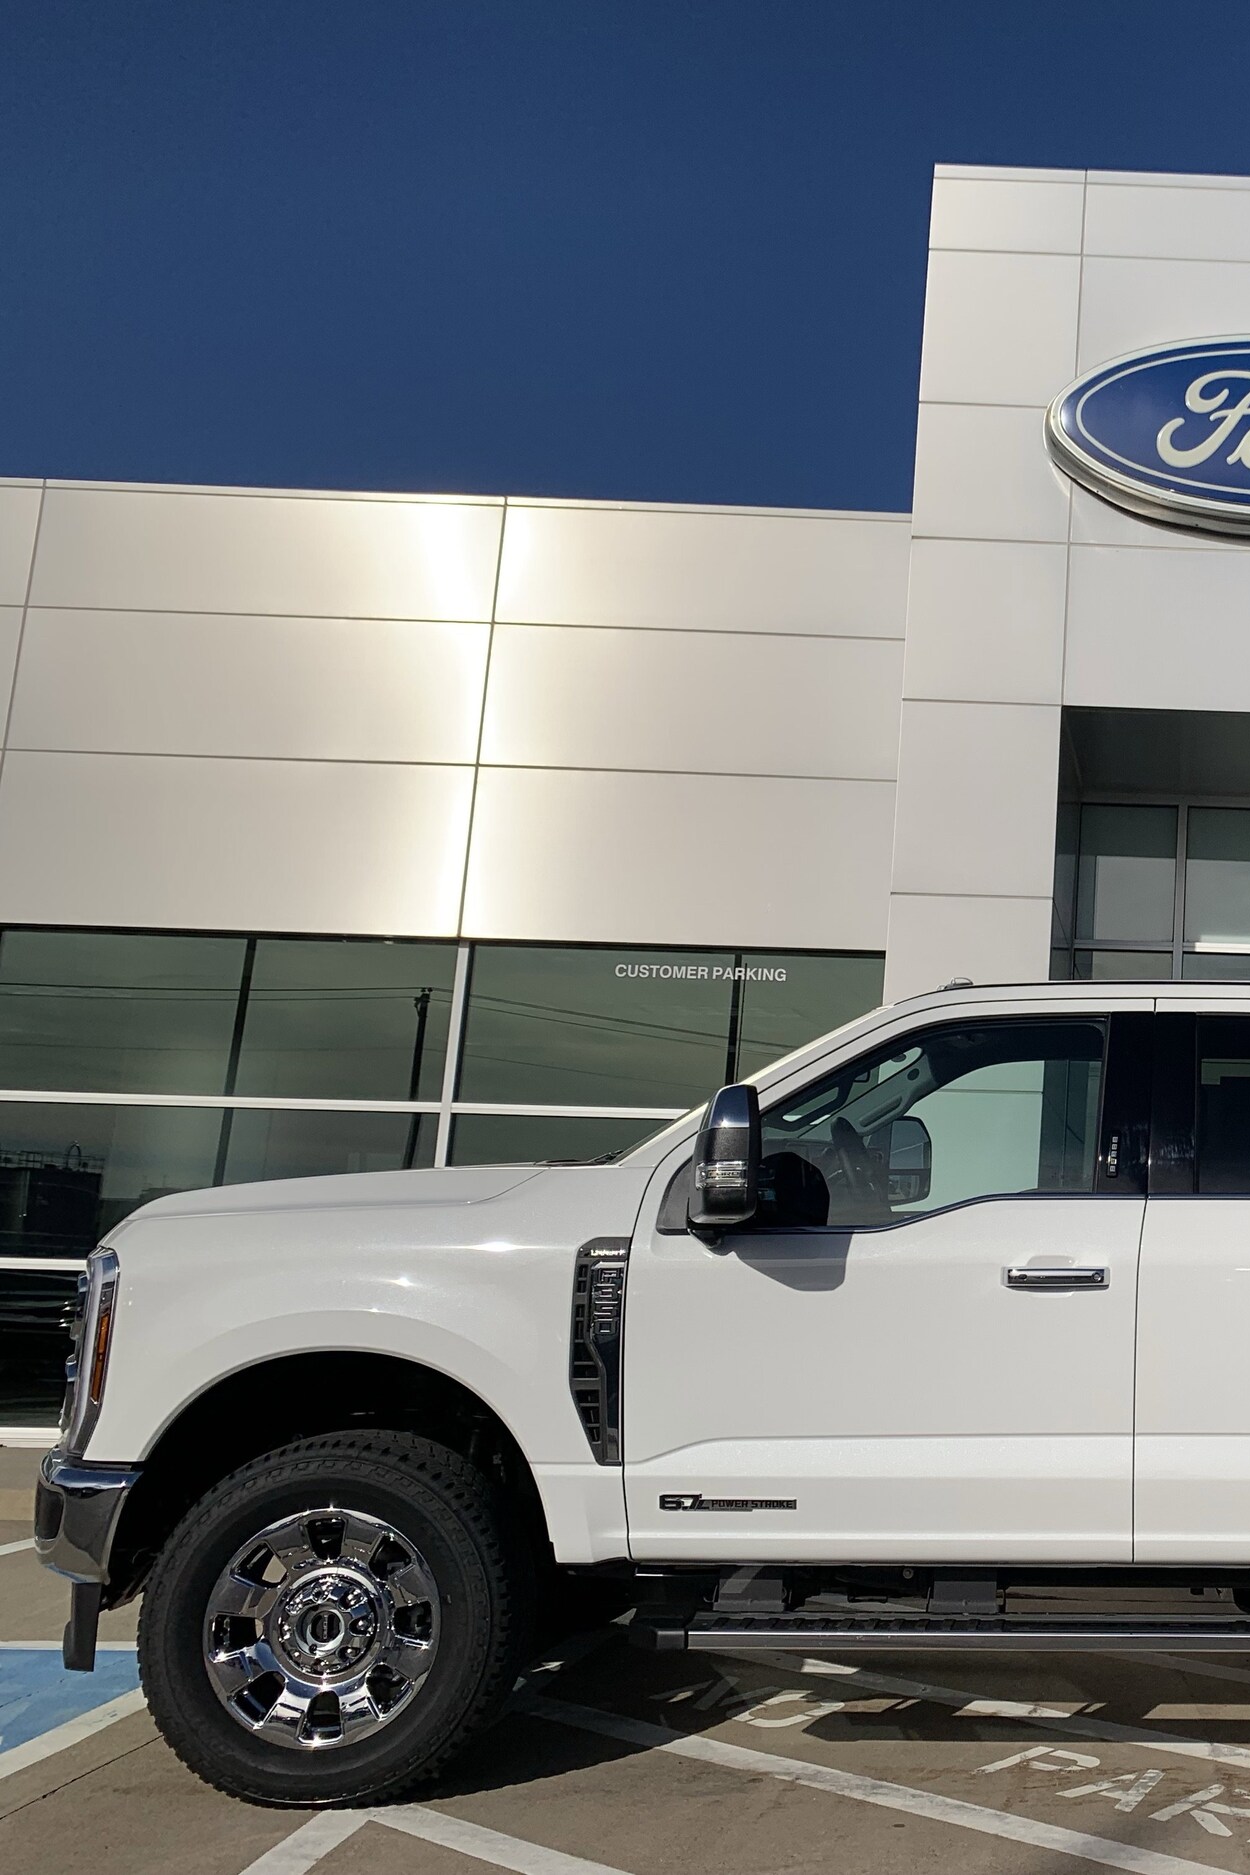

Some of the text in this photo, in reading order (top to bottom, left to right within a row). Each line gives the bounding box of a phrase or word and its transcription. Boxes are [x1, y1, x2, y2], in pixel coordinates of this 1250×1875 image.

[614, 964, 787, 982] CUSTOMER PARKING
[711, 1500, 748, 1509] POWER
[750, 1500, 794, 1509] STROKE
